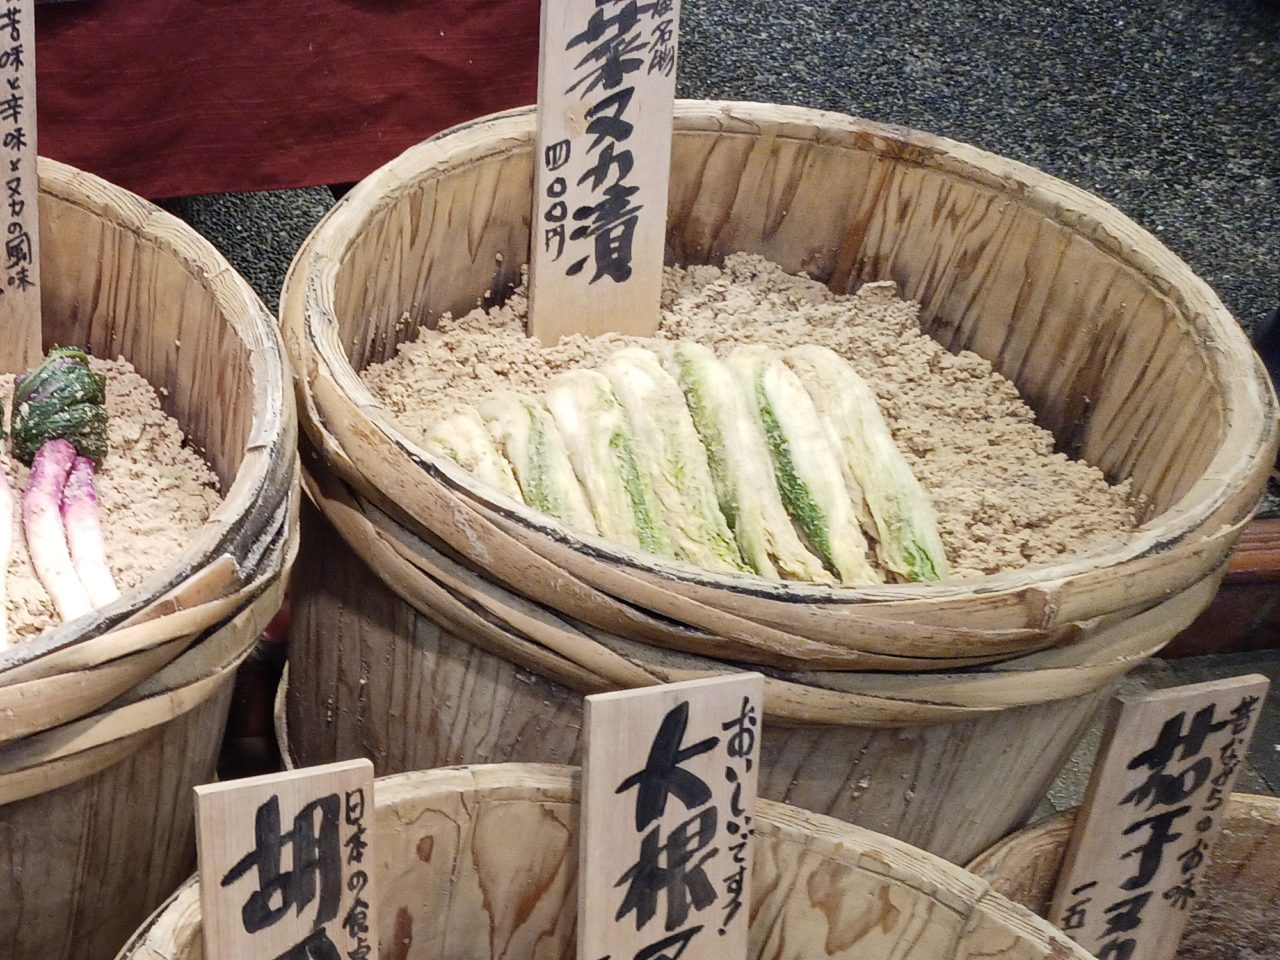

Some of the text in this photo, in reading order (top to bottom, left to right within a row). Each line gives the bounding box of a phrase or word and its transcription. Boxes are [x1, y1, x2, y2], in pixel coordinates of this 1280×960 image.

[564, 0, 657, 286] 菜ヌカ漬
[1060, 880, 1099, 942] 一五
